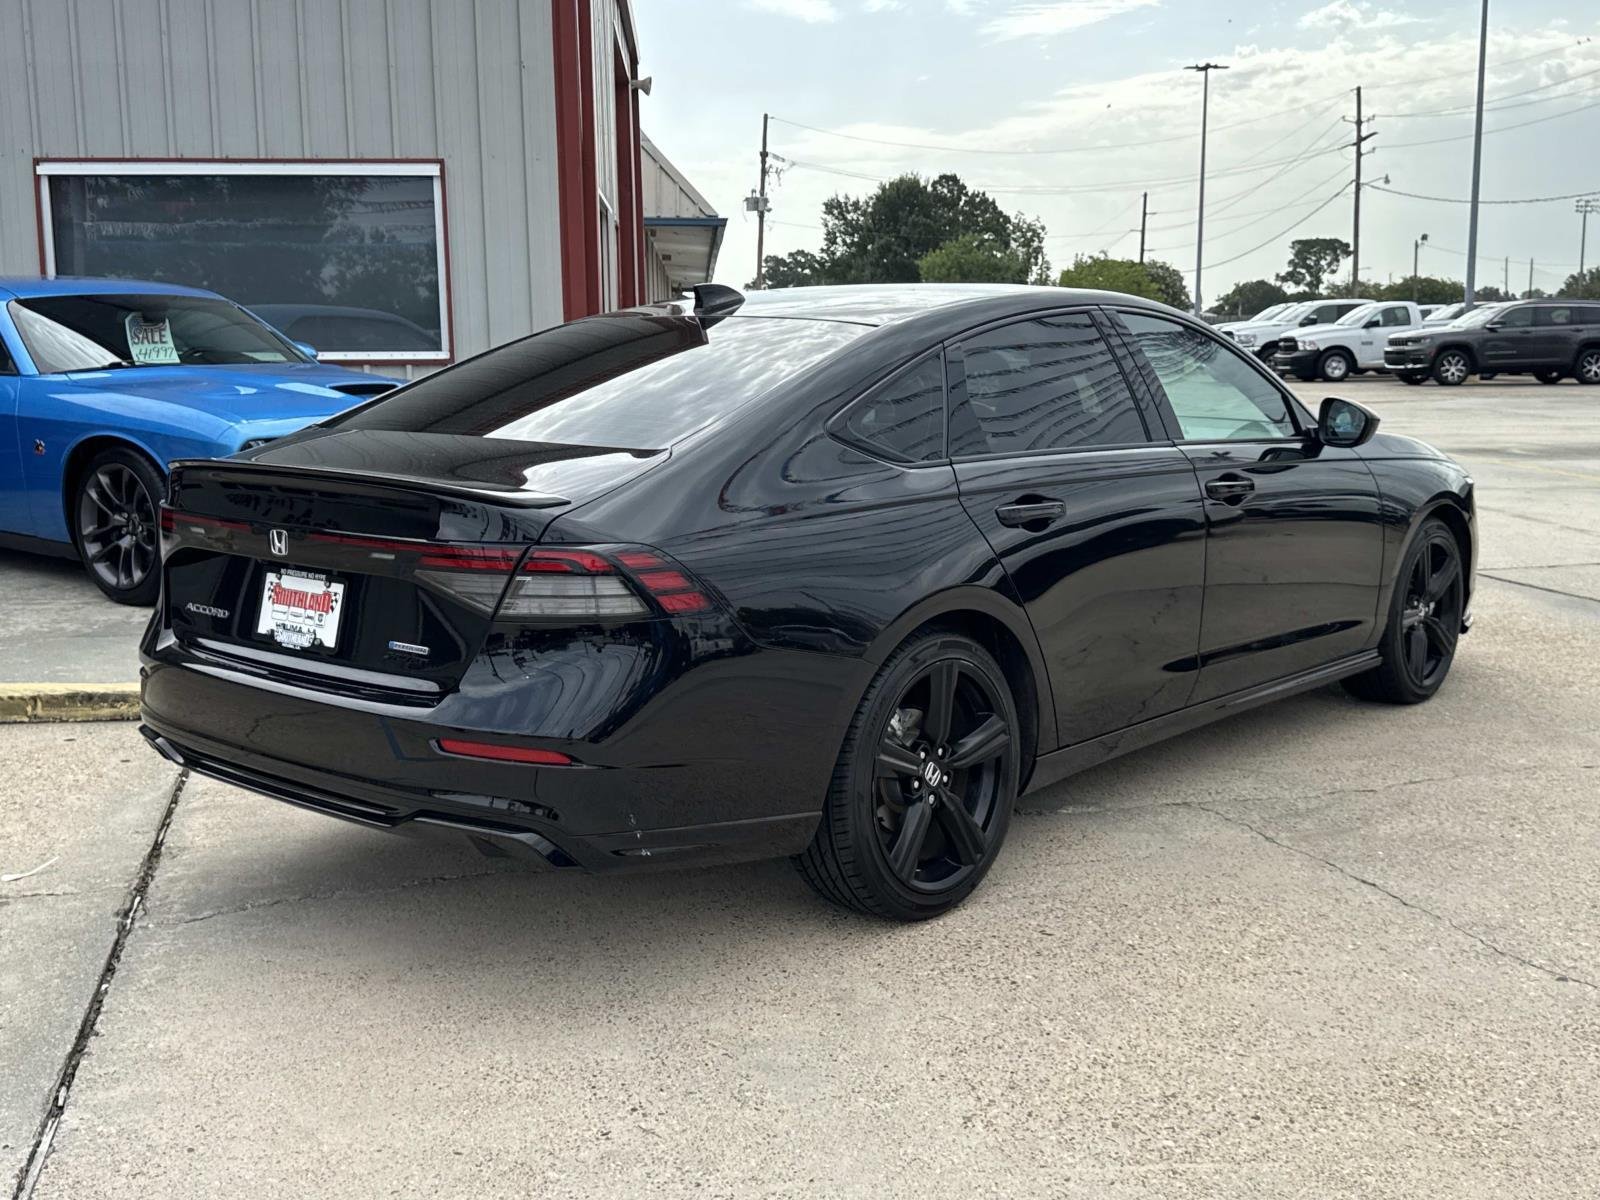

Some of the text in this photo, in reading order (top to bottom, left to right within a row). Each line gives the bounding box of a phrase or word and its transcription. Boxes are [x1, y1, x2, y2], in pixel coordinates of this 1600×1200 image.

[131, 326, 168, 346] SALE
[314, 573, 327, 581] HYPE
[272, 582, 332, 615] SOUTHLAND
[185, 602, 229, 618] ACCORD
